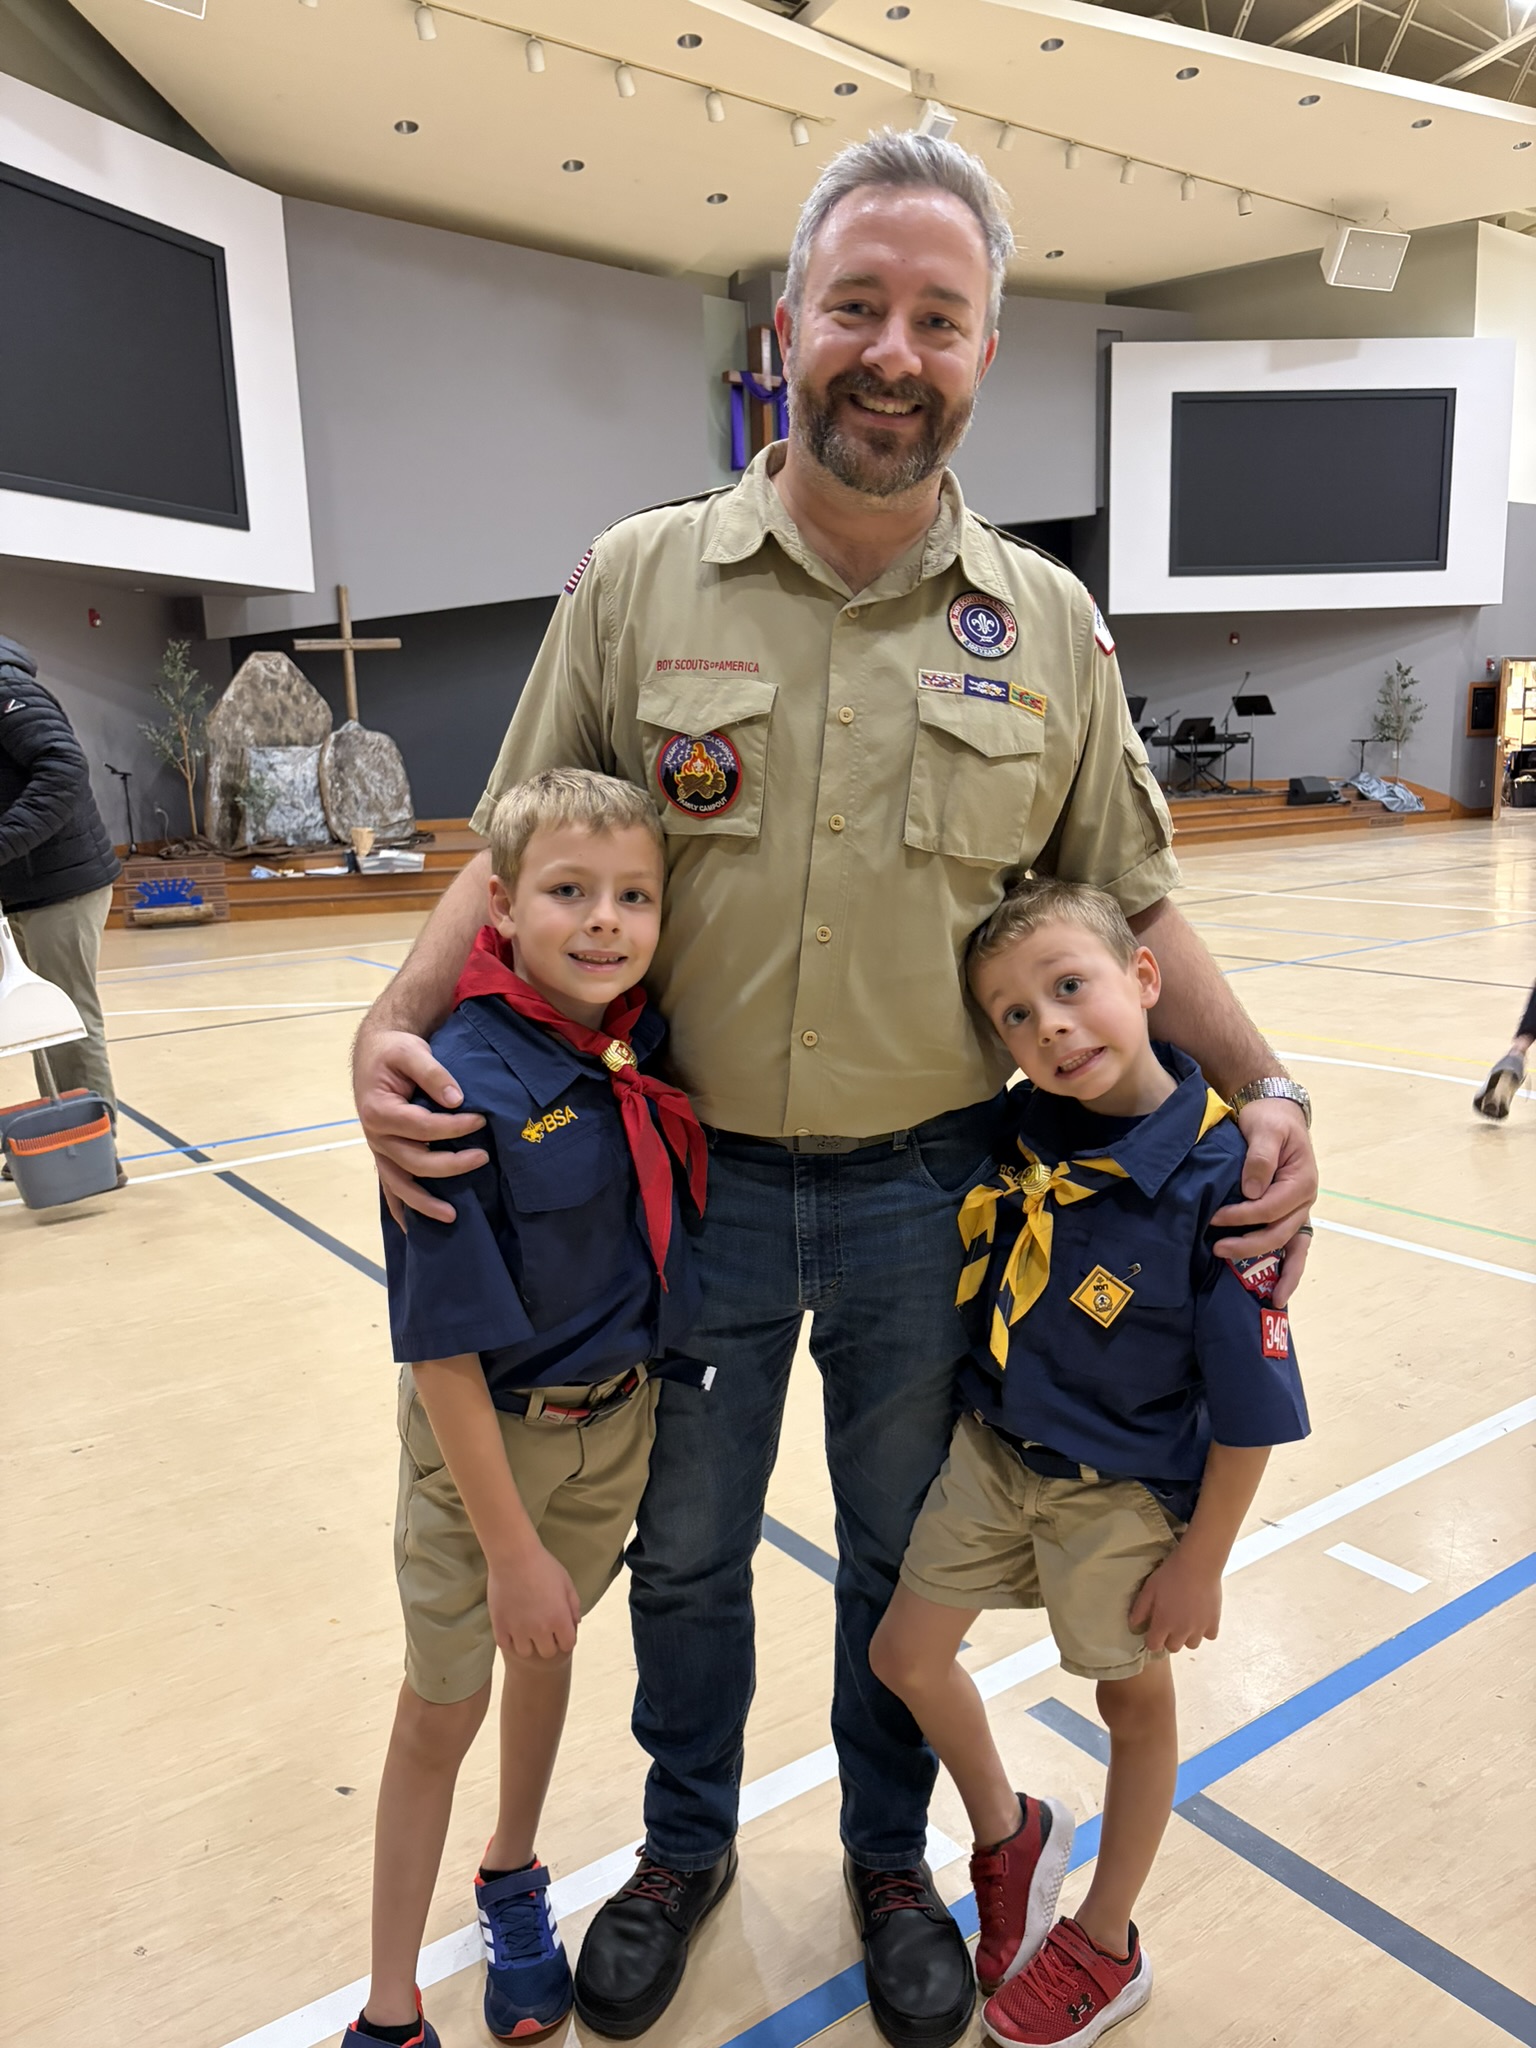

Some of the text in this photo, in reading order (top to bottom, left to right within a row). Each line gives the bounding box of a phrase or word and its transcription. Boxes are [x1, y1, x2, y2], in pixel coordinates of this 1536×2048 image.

[656, 660, 673, 671] BOY
[674, 659, 710, 671] SCOUTS
[718, 660, 760, 673] AMERICA
[699, 796, 729, 812] CAMPOUT
[542, 1105, 579, 1133] BSA
[1093, 1283, 1109, 1292] LION
